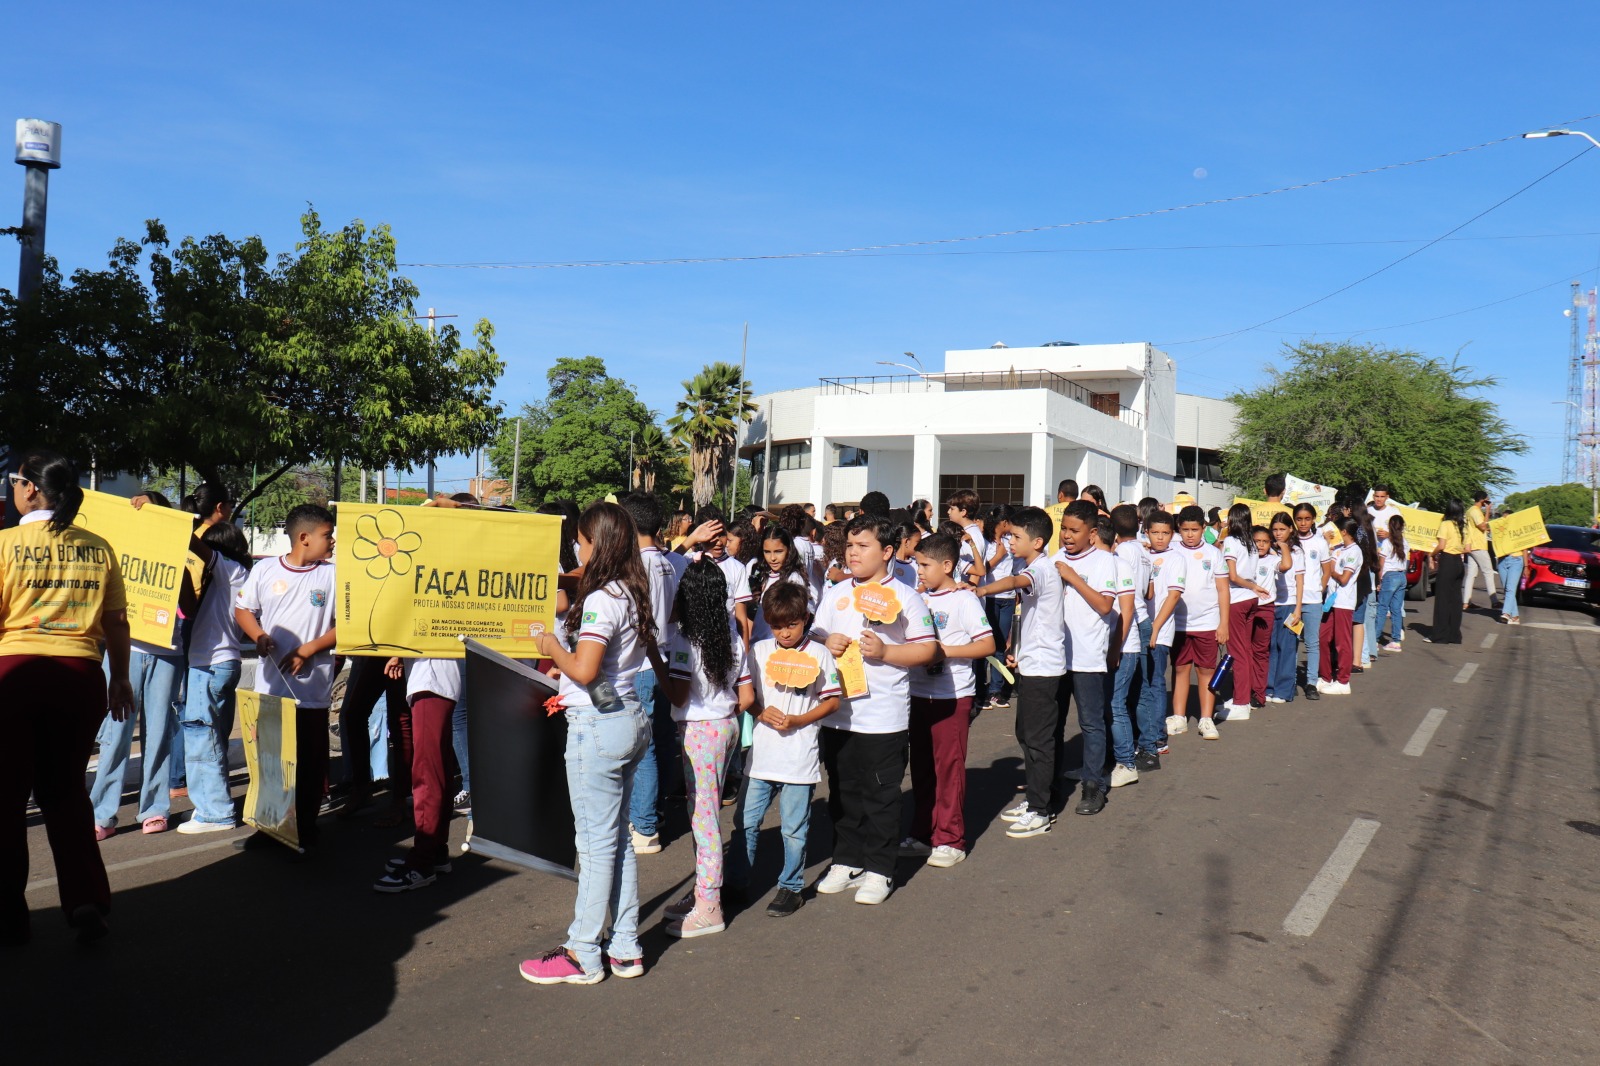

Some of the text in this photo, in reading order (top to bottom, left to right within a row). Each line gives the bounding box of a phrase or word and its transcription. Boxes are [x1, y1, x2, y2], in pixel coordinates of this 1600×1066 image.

[14, 545, 105, 564] FAÇA BONITO
[121, 554, 176, 590] BONITO
[26, 579, 100, 590] FACABONITO.ORG
[414, 565, 548, 600] FAÇA BONITO
[413, 599, 440, 608] PROTEJA
[441, 600, 465, 610] NOSSAS
[466, 602, 496, 612] CRIANÇAS
[497, 603, 501, 611] E
[860, 595, 888, 607] LARANJA
[458, 626, 488, 634] EXPLORAÇÃO
